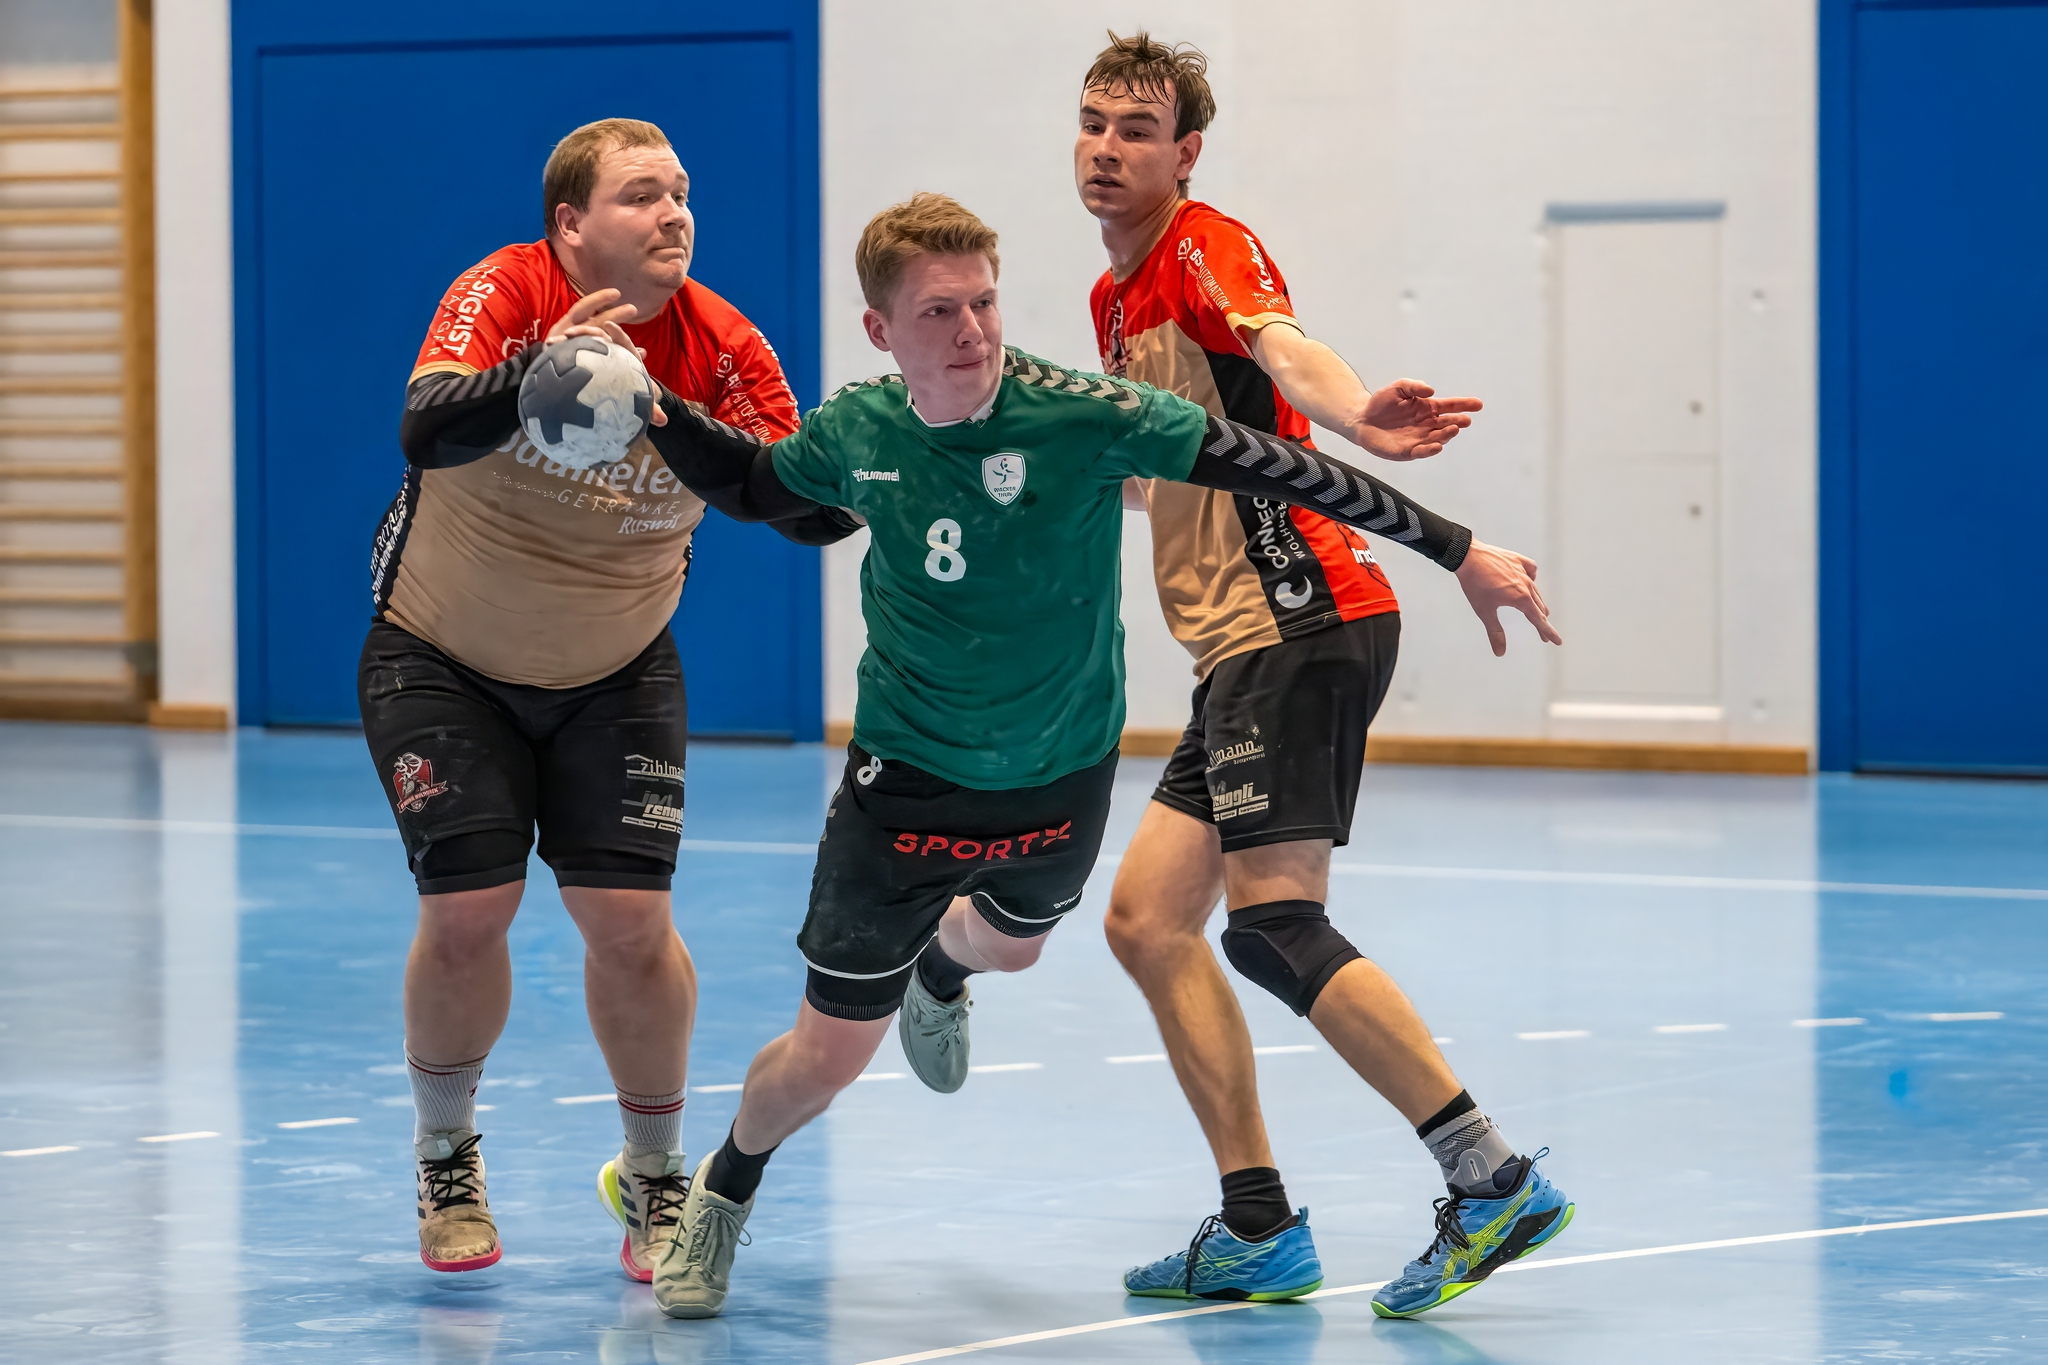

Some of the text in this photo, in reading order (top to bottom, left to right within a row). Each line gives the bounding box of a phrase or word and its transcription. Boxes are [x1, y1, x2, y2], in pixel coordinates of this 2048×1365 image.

[443, 280, 496, 357] SIGRIST
[858, 468, 900, 482] hummel
[924, 518, 967, 582] 8
[856, 755, 883, 786] 8
[893, 820, 1072, 861] SPORTX
